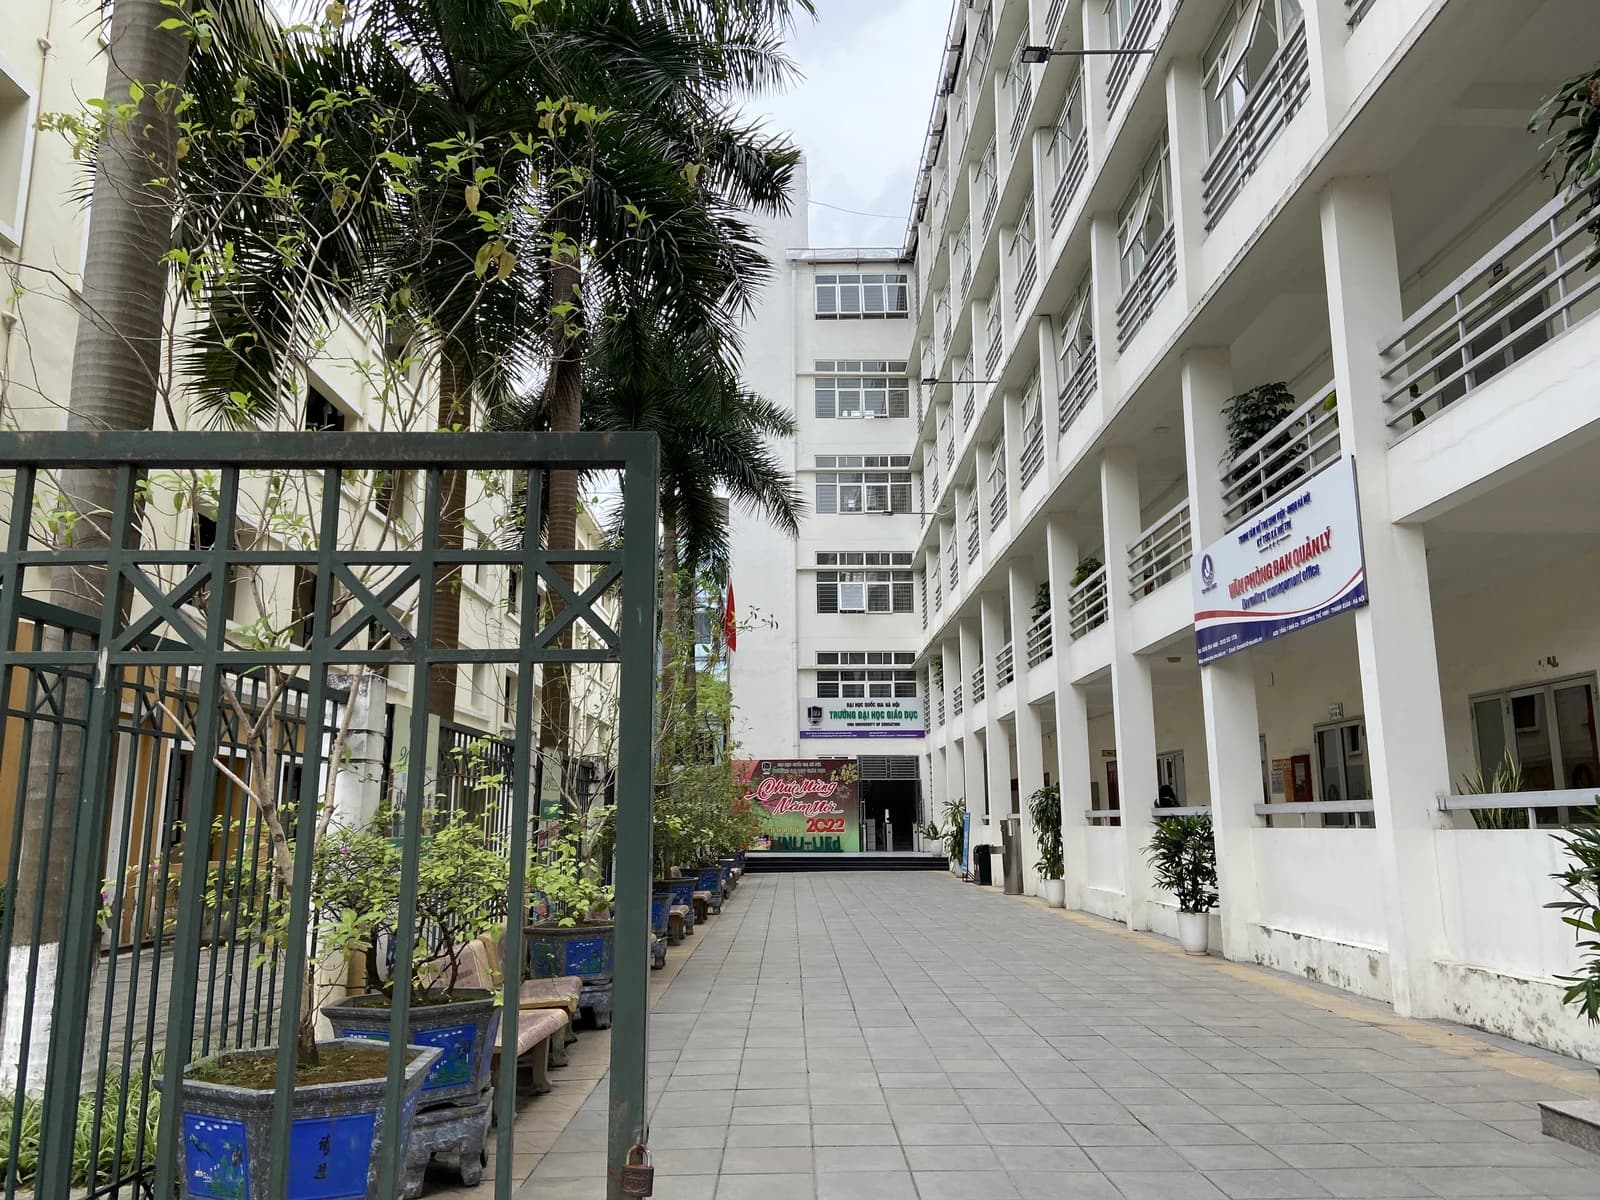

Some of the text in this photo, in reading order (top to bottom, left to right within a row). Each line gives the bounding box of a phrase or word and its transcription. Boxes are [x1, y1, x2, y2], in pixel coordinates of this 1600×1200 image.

[1228, 576, 1245, 599] VĂN
[1244, 566, 1273, 592] PHÒNG
[1272, 553, 1293, 577] BAN
[1292, 536, 1321, 567] QUẢN
[1320, 526, 1332, 552] LÝ
[1241, 588, 1267, 610] Dormitory
[1266, 570, 1303, 599] management
[1302, 563, 1320, 584] office
[829, 709, 918, 721] TRƯỜNG ĐẠI HỌC GIÁO DỤC
[744, 777, 838, 801] Chúc Mừng
[772, 796, 812, 815] Năm
[806, 818, 846, 833] 2022
